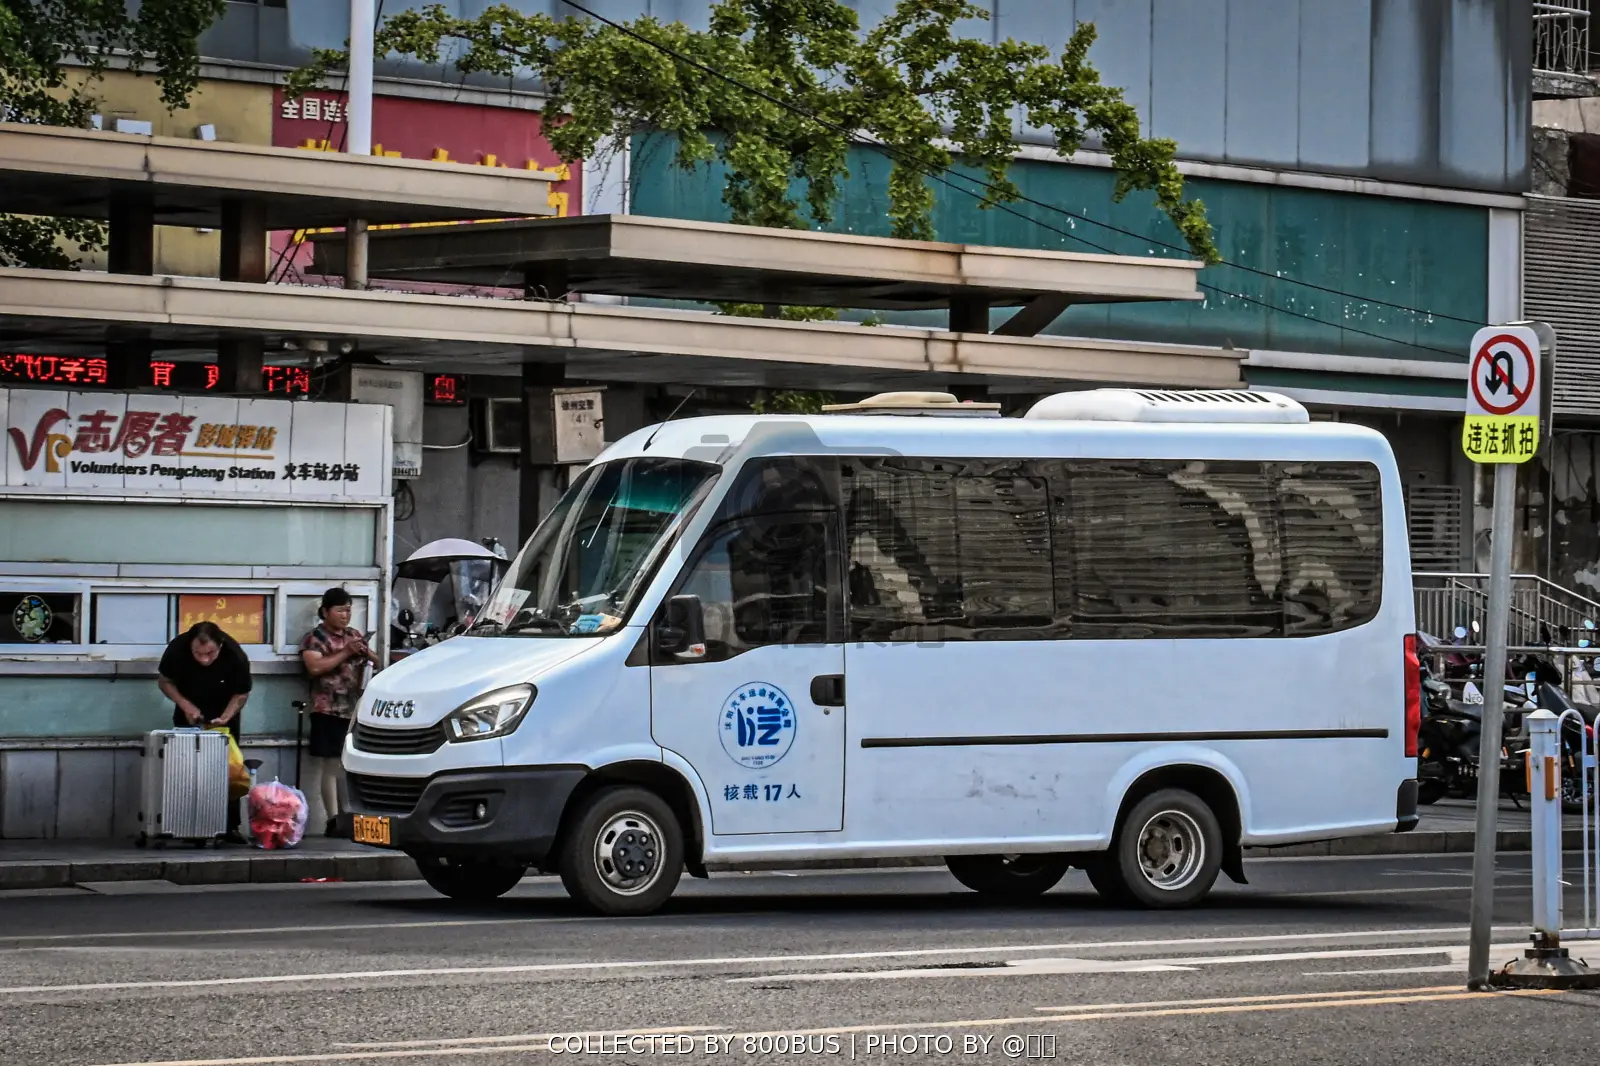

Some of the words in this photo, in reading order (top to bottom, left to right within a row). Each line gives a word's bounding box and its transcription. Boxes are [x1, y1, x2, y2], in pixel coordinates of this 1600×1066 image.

[71, 409, 196, 459] 志愿者
[194, 423, 277, 450] 彭城驿站
[1467, 422, 1535, 456] 违法抓拍
[71, 460, 148, 476] Volunteers
[150, 463, 226, 482] Pengcheng
[228, 466, 276, 480] Station
[282, 462, 360, 482] 火车站分站
[371, 698, 415, 718] IVECO
